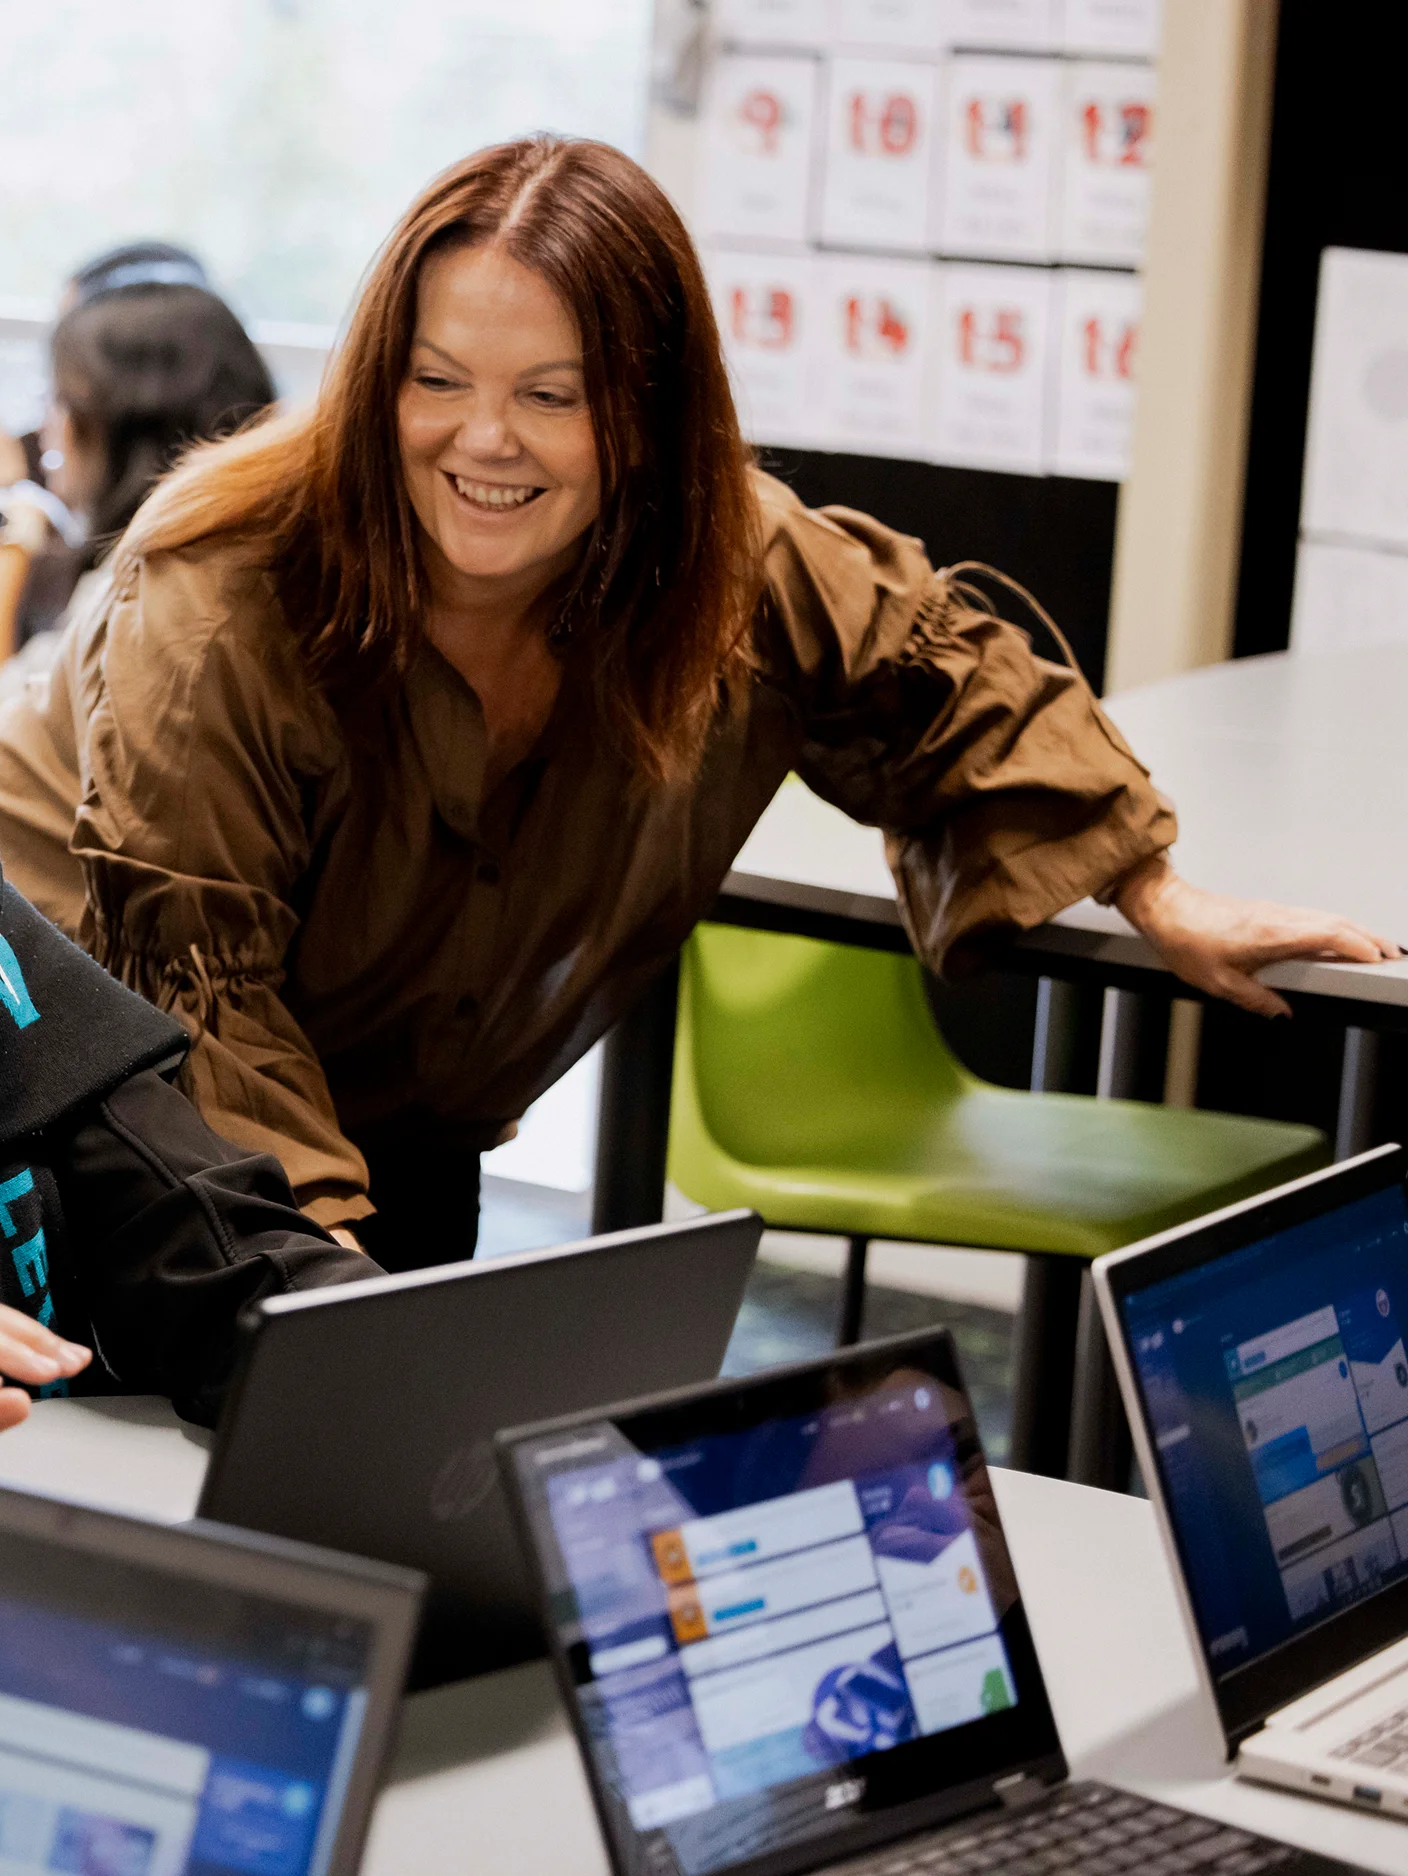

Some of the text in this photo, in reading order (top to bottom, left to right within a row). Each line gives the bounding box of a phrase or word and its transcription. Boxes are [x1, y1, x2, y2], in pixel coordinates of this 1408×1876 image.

[740, 89, 783, 156] 9
[848, 92, 918, 156] 10
[1080, 101, 1149, 166] 12
[957, 307, 1025, 373] 15
